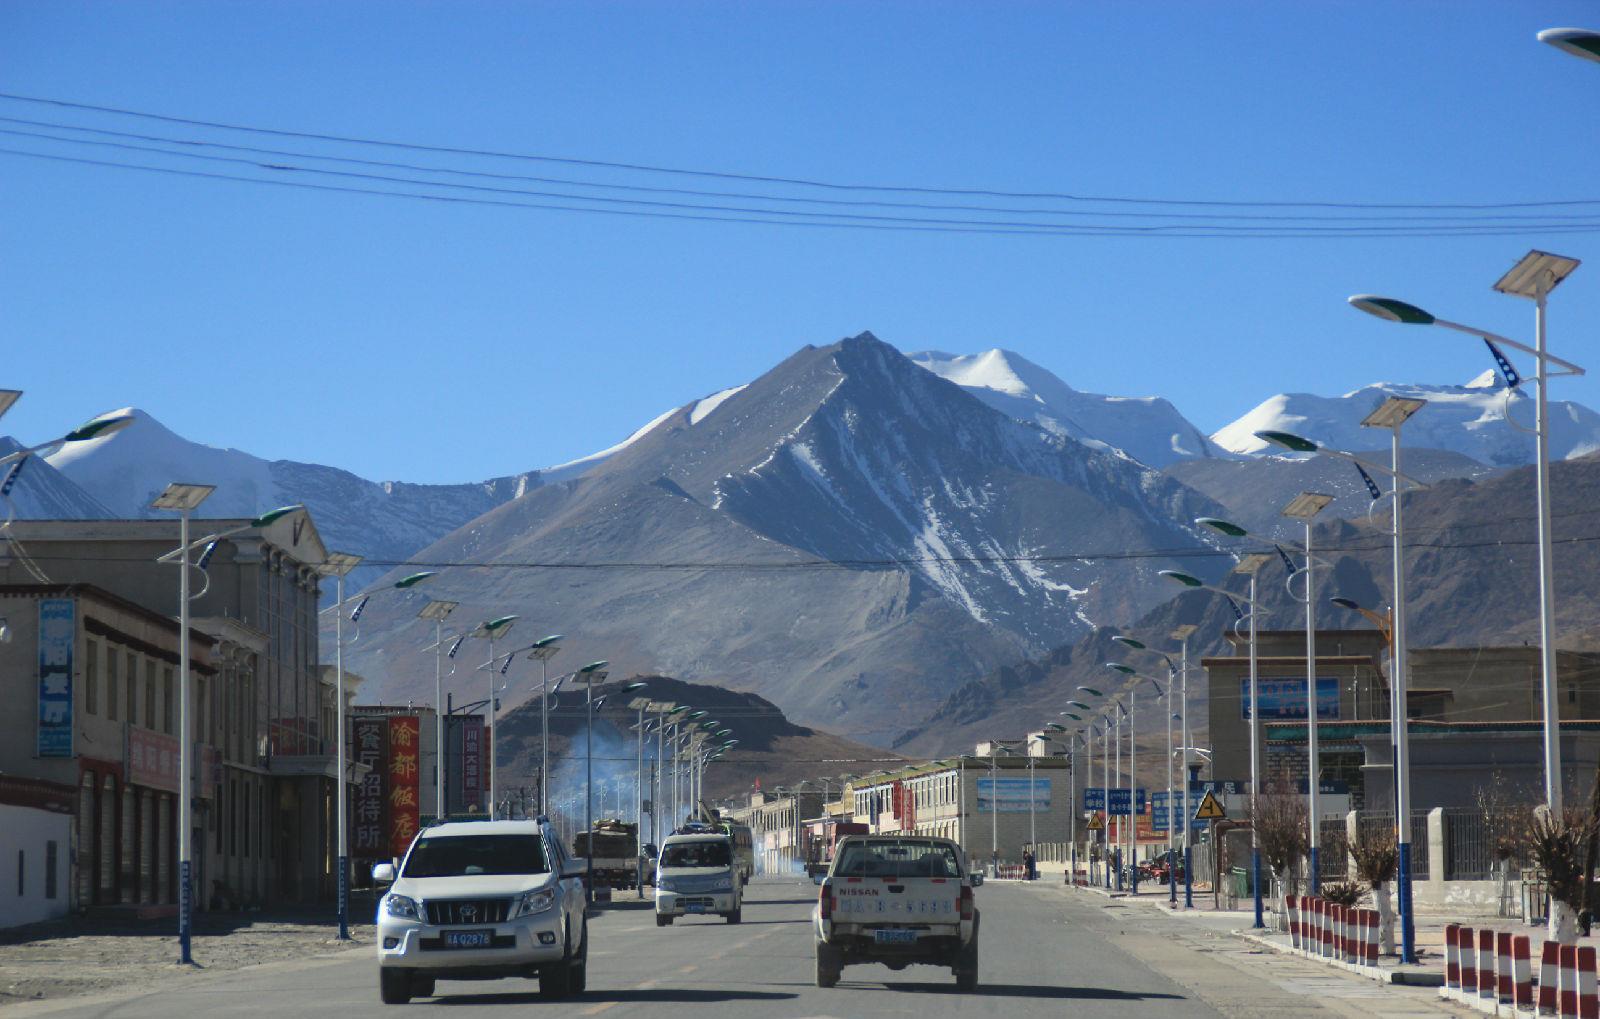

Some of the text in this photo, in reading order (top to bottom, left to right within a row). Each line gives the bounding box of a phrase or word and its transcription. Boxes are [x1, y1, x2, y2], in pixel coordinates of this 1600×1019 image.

[356, 724, 381, 849] 餐厅招待所
[388, 721, 419, 840] 渝都饭店
[840, 888, 879, 896] NISSAN
